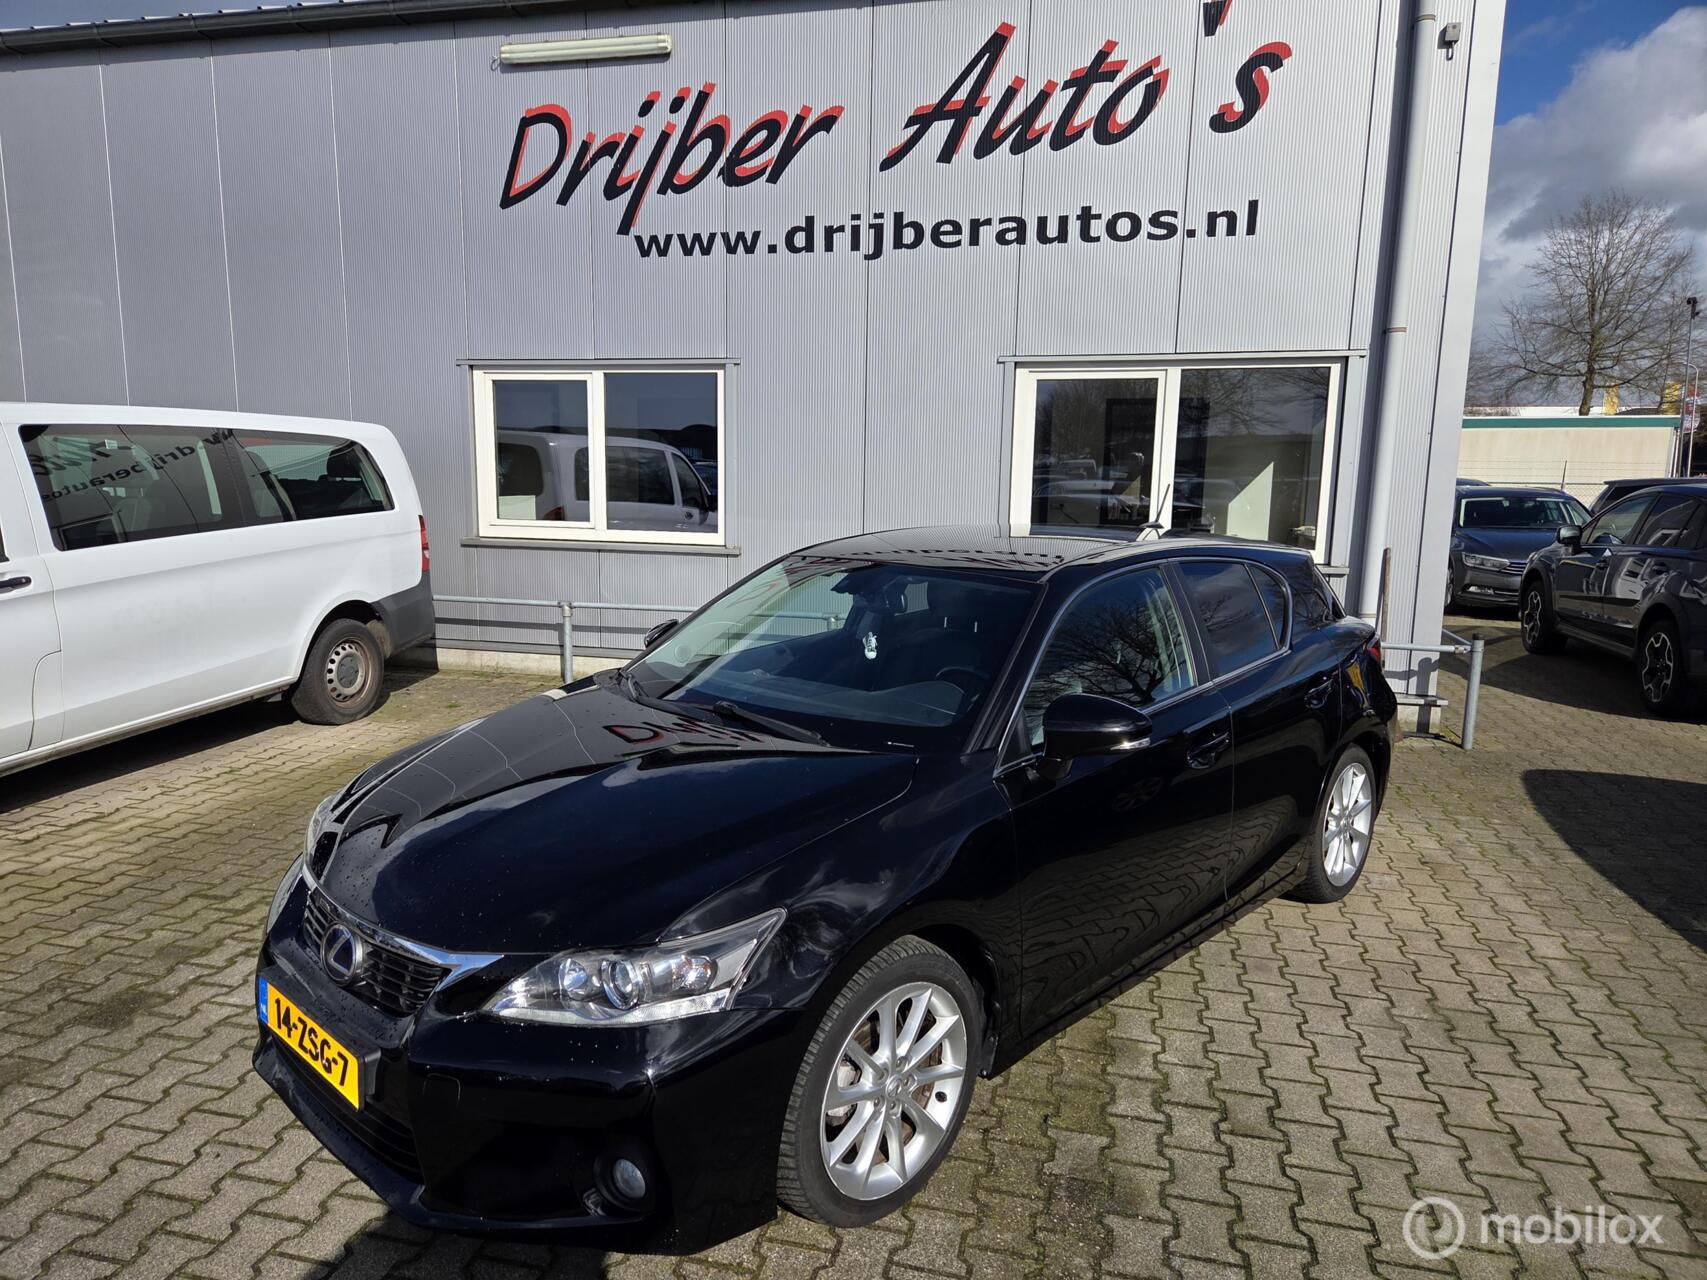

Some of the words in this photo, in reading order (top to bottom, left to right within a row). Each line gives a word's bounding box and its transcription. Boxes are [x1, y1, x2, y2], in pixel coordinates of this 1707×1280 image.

[499, 81, 845, 236] Drijber
[879, 0, 1293, 172] Auto's
[634, 199, 1259, 261] www.drijberautos.nl
[275, 998, 349, 1086] 14-ZSG-7
